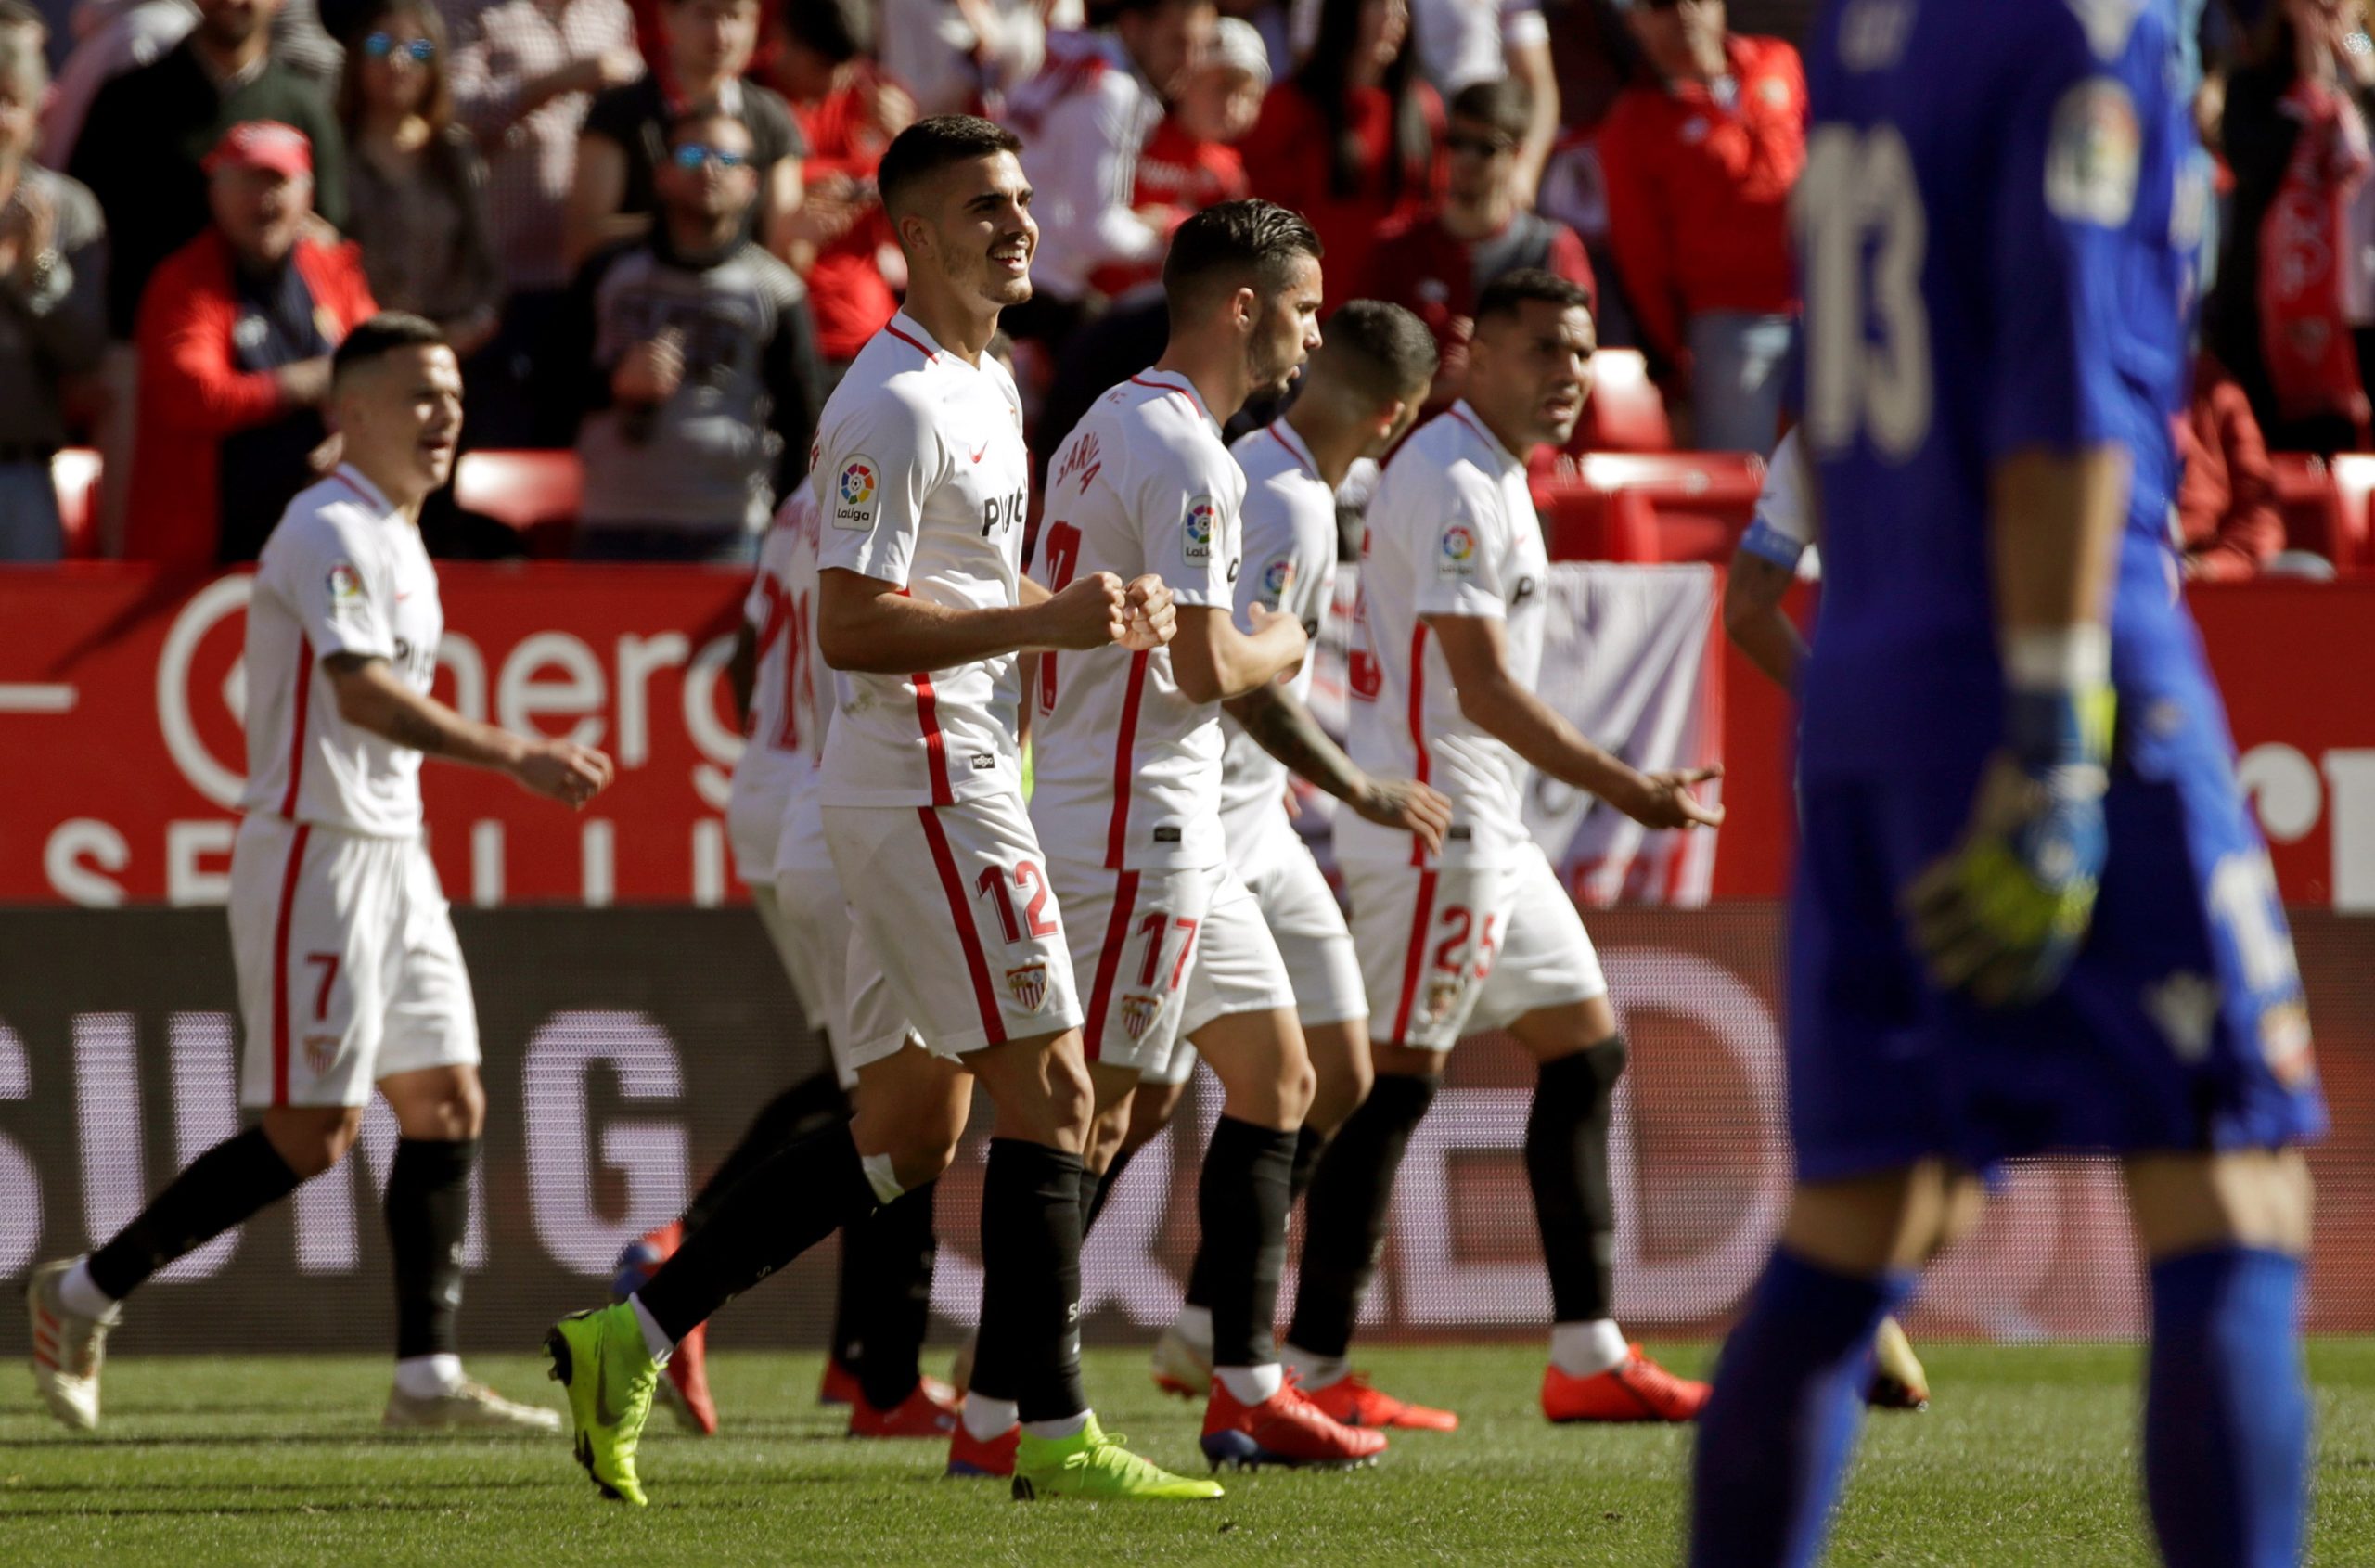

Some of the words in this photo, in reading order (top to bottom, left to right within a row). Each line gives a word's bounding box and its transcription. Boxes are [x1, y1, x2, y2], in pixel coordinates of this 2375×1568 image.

[1789, 121, 1935, 464] 13
[837, 507, 870, 521] LaLiga
[975, 860, 1059, 945] 12
[1136, 911, 1199, 993] 17
[1433, 905, 1496, 980] 25
[305, 952, 340, 1022] 7
